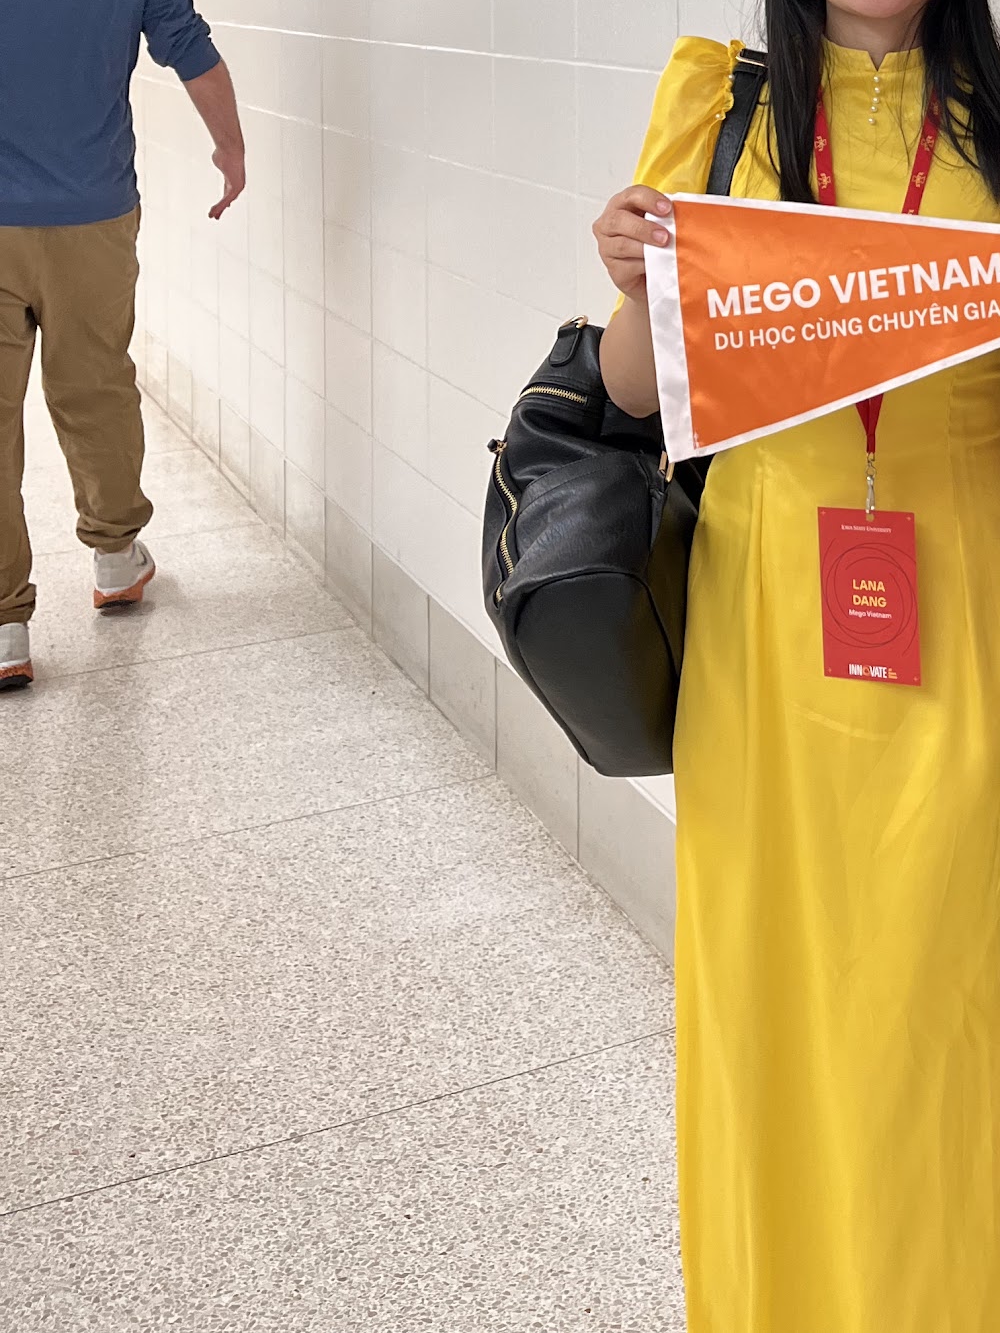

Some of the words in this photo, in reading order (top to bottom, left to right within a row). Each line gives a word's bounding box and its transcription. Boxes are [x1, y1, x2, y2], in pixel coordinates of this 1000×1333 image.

[706, 277, 821, 319] MEGO
[714, 330, 744, 350] DU
[749, 325, 796, 350] HỌC
[801, 317, 863, 342] CÙNG
[867, 303, 959, 333] CHUYÊN
[852, 578, 886, 592] LANA
[852, 594, 887, 608] DANG
[848, 608, 866, 618] Mego
[866, 610, 892, 619] Vietnam
[848, 663, 888, 679] INNOVATE
